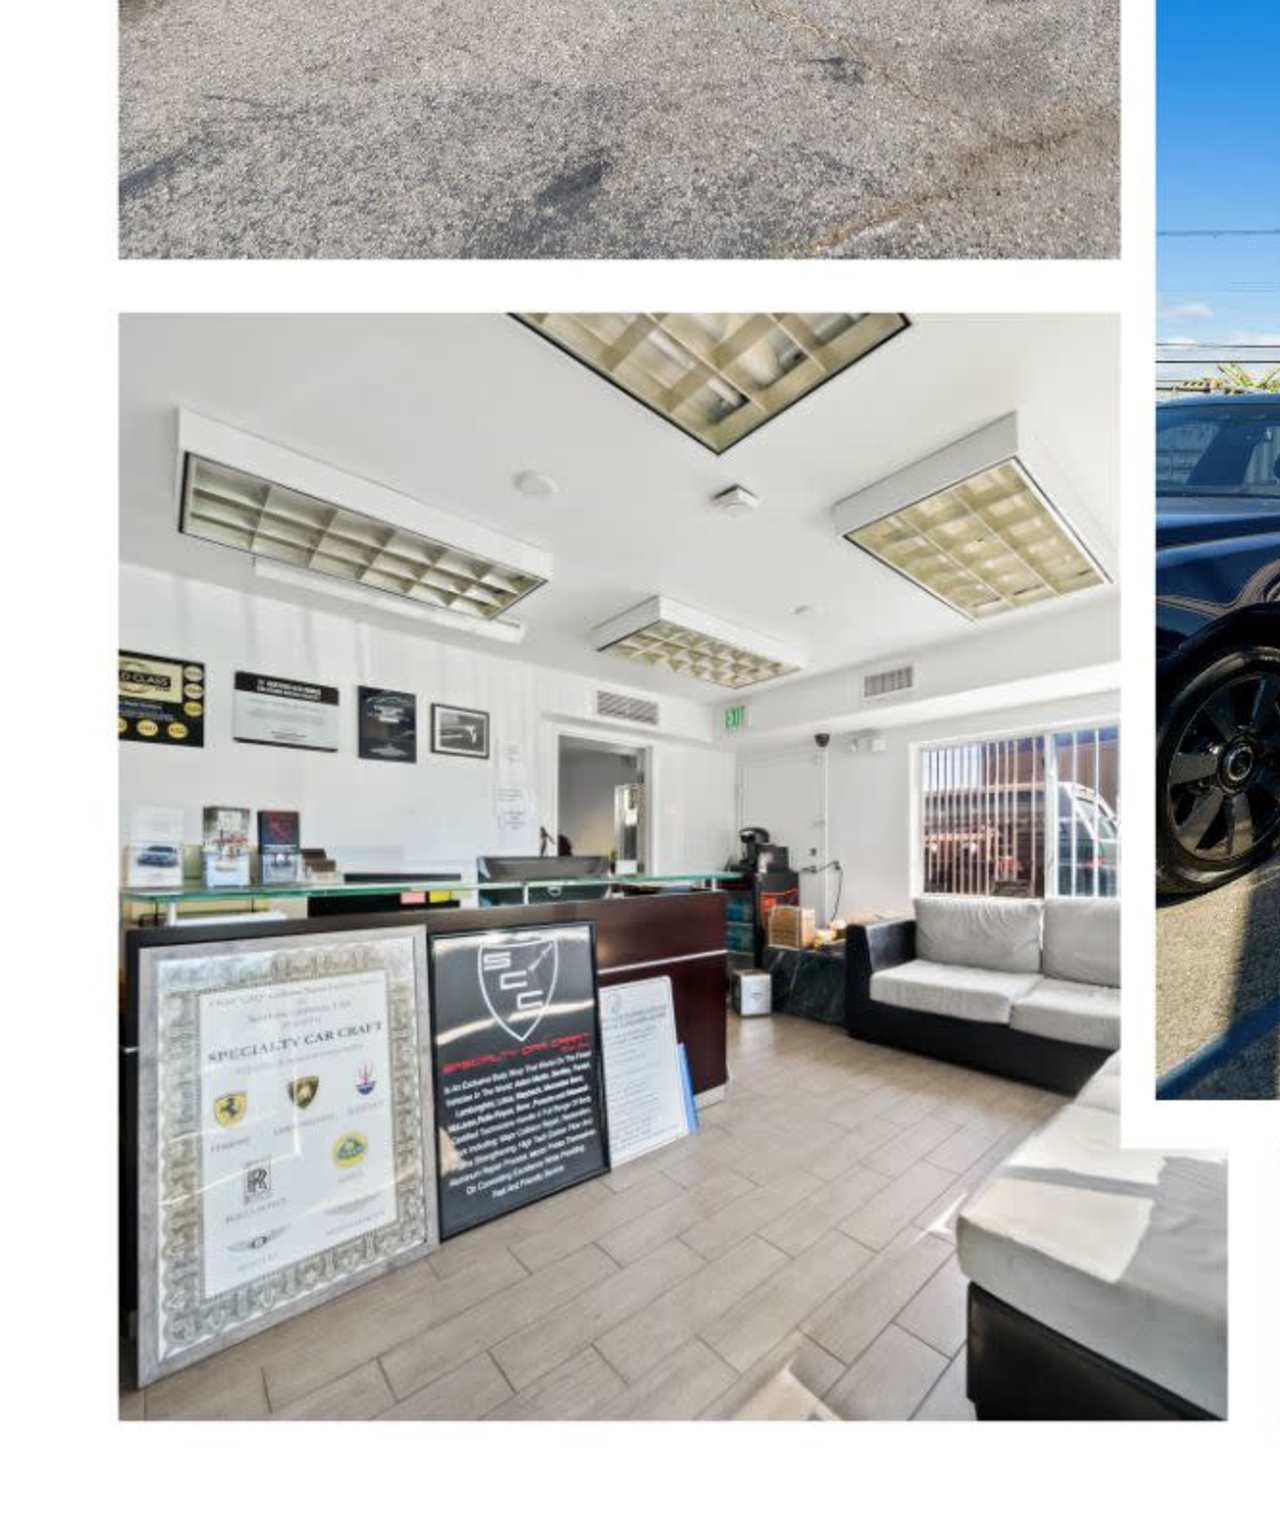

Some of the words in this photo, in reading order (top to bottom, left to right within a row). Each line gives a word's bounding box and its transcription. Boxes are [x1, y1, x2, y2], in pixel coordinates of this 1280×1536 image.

[209, 1035, 300, 1062] SPECIALTY
[304, 1031, 335, 1045] CAR
[337, 1021, 382, 1037] CRAFT
